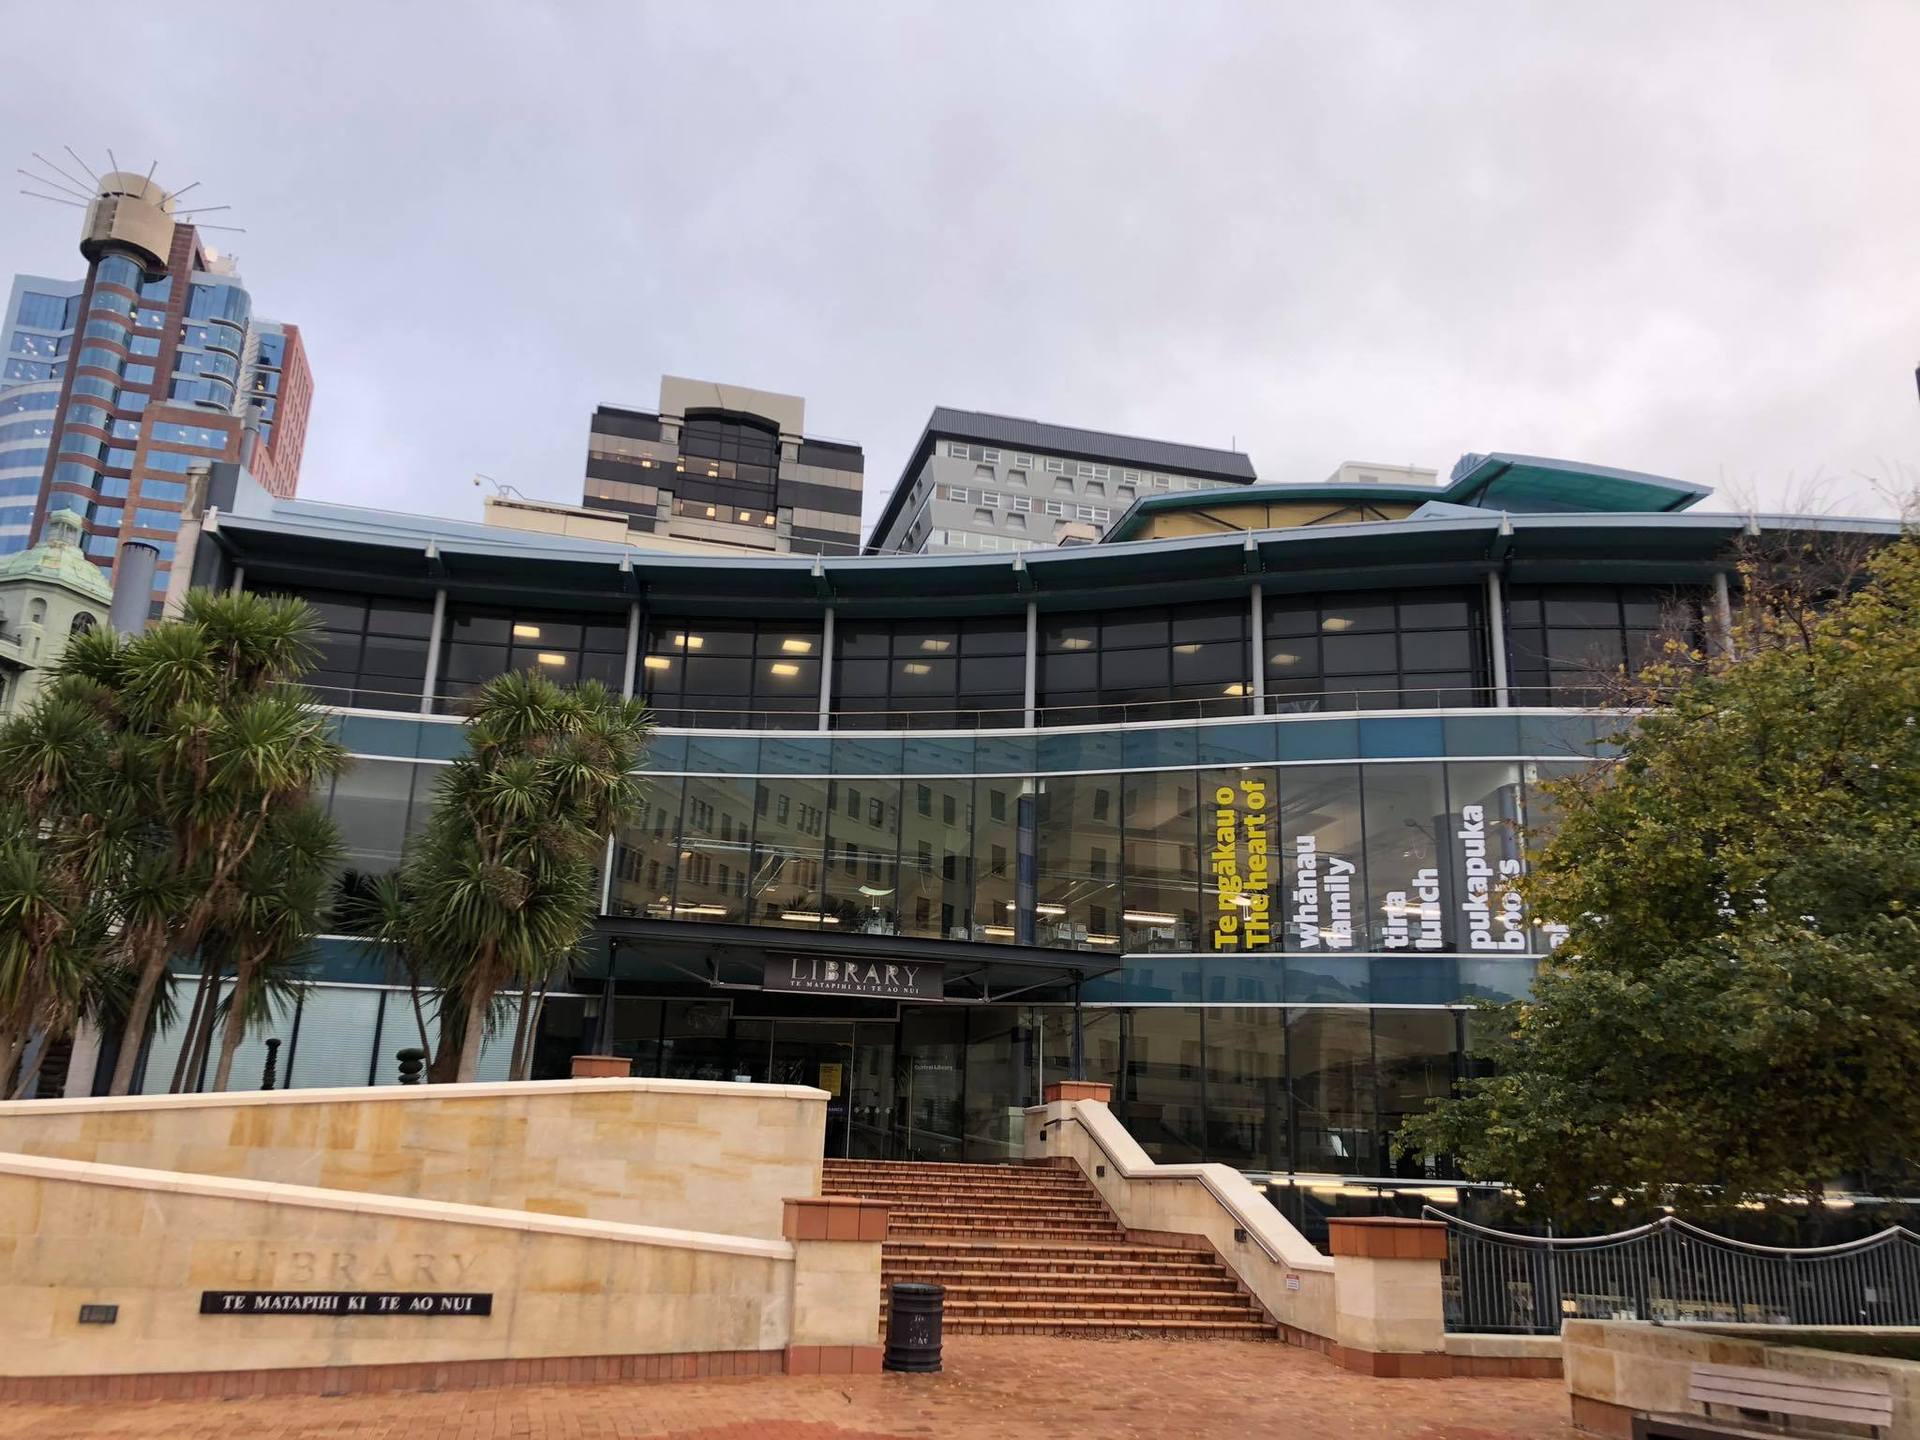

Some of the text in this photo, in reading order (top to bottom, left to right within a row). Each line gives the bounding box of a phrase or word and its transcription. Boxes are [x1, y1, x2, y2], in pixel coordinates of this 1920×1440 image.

[1212, 786, 1242, 949] Te ngākau o
[1241, 780, 1270, 949] The heart of
[1293, 836, 1320, 948] whānau
[1324, 857, 1356, 949] family
[1457, 805, 1498, 949] pukapuka
[1381, 891, 1409, 948] tina
[1411, 868, 1443, 949] lunch
[790, 958, 920, 987] LIBRARY
[806, 982, 851, 990] MATAPIHI
[222, 1294, 474, 1312] TE MATAPIHI KI TE AO NUI
[232, 1251, 486, 1284] LIBRARY
